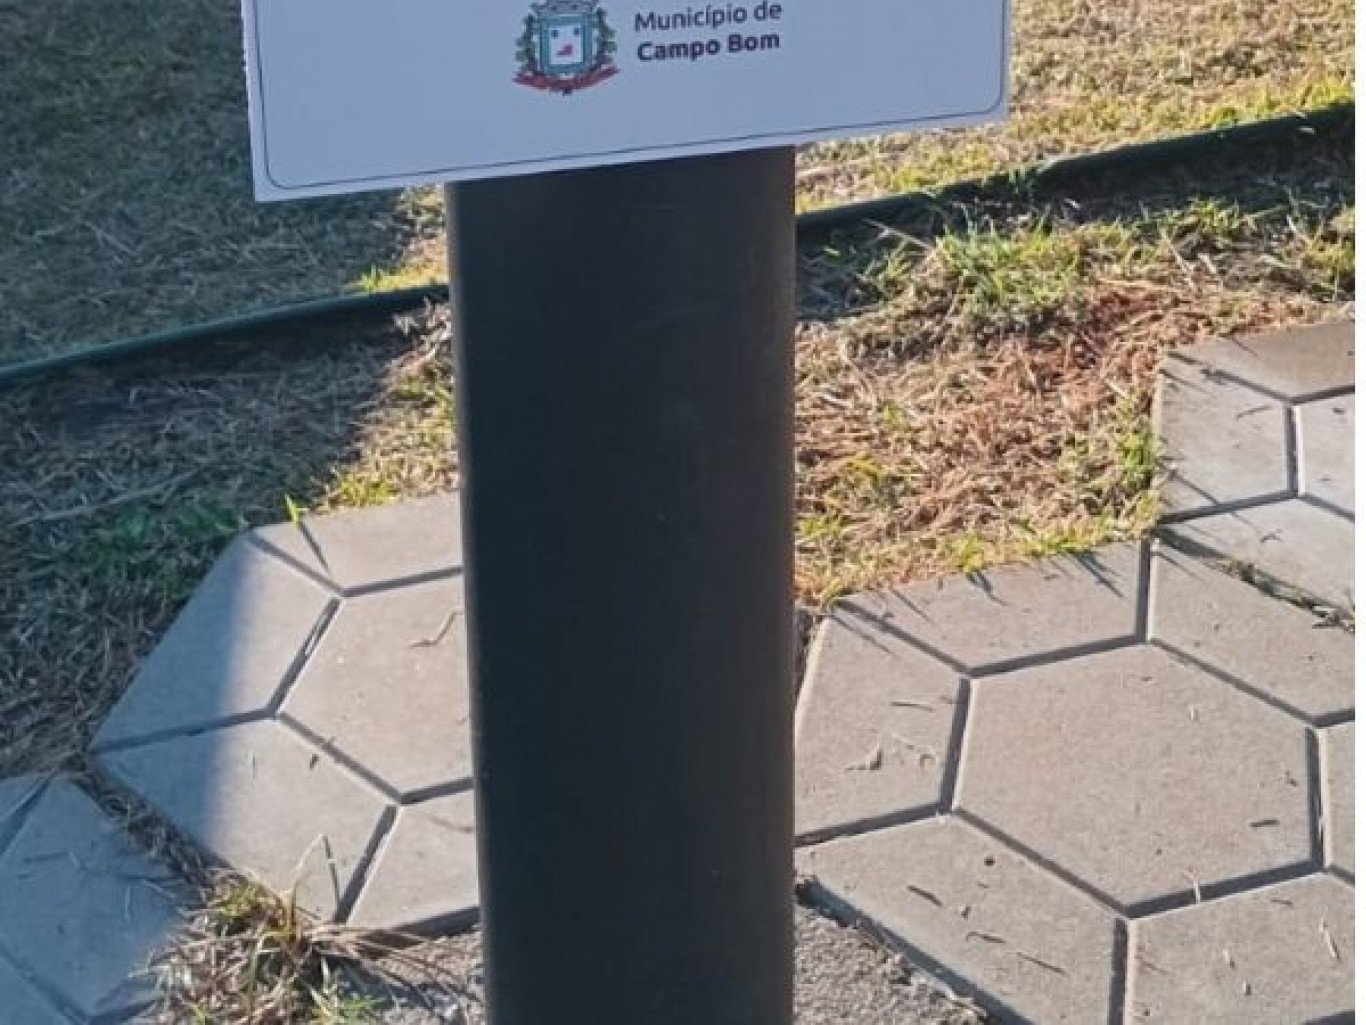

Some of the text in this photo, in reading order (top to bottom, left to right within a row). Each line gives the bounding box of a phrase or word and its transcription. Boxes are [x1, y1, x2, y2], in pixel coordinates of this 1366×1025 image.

[635, 0, 782, 32] Município de
[637, 34, 779, 62] Campo Bom
